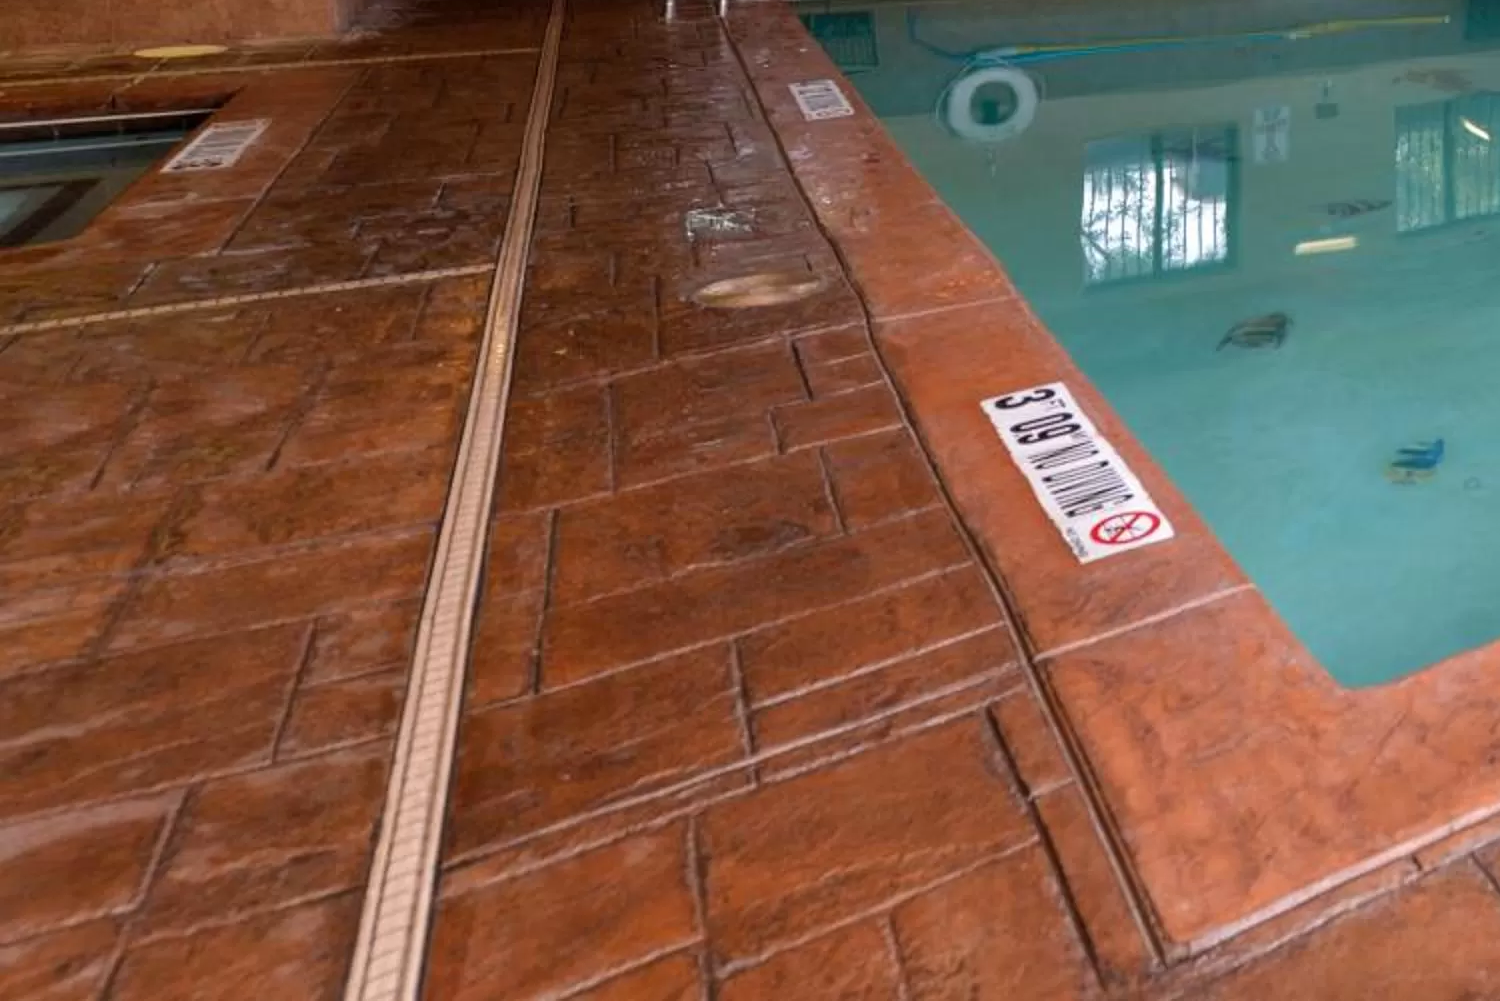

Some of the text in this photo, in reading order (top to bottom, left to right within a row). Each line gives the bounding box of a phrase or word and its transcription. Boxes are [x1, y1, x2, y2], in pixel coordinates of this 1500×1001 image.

[994, 388, 1056, 409] 3
[1027, 441, 1100, 470] NO
[1042, 461, 1135, 517] DIVING
